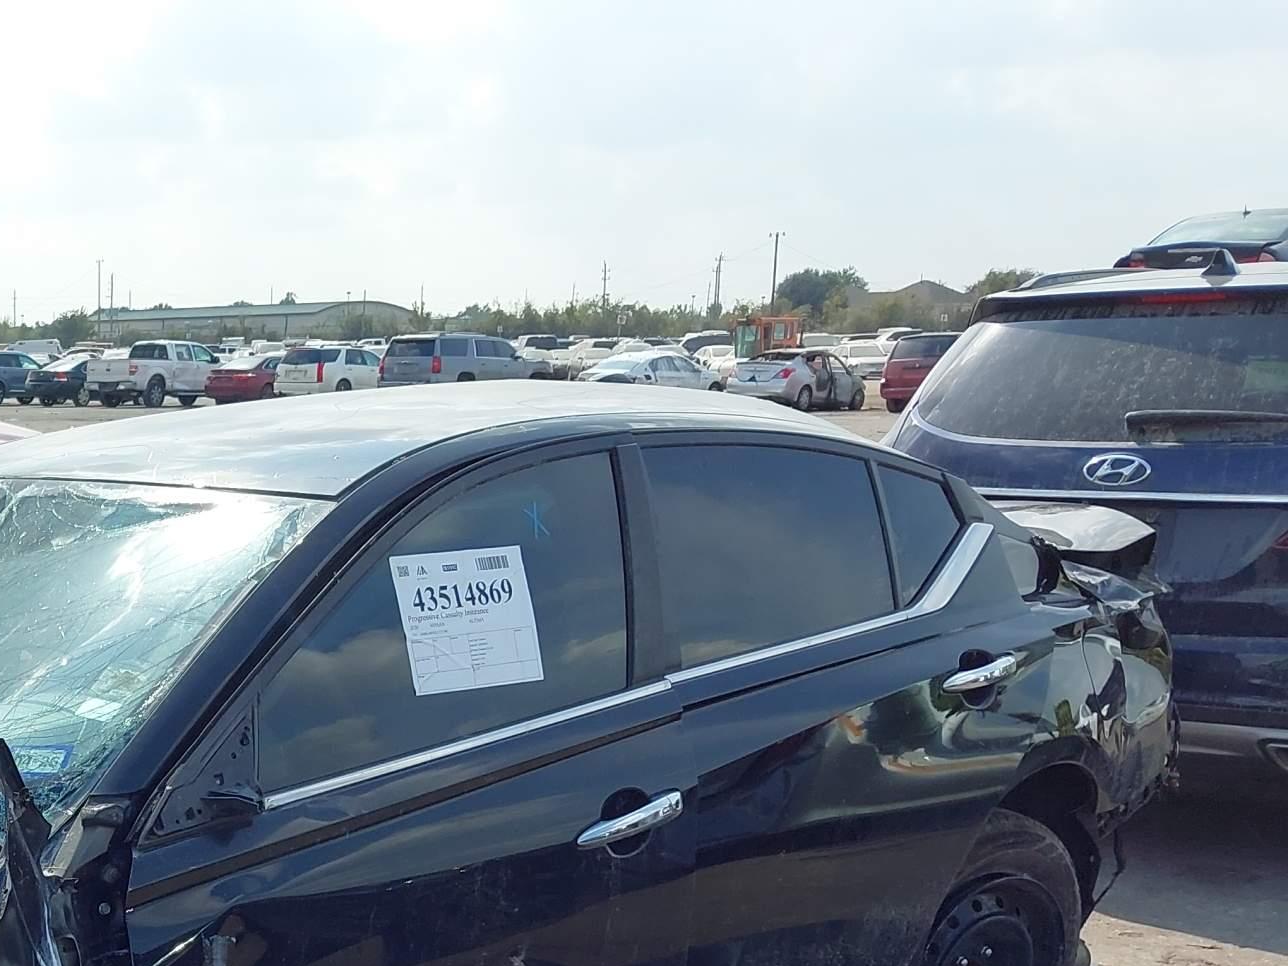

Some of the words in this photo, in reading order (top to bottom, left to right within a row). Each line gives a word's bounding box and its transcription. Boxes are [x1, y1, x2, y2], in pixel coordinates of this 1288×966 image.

[412, 578, 513, 612] 43514869
[408, 613, 439, 624] Progressive
[440, 610, 463, 620] Casualty
[464, 608, 489, 617] Insurance
